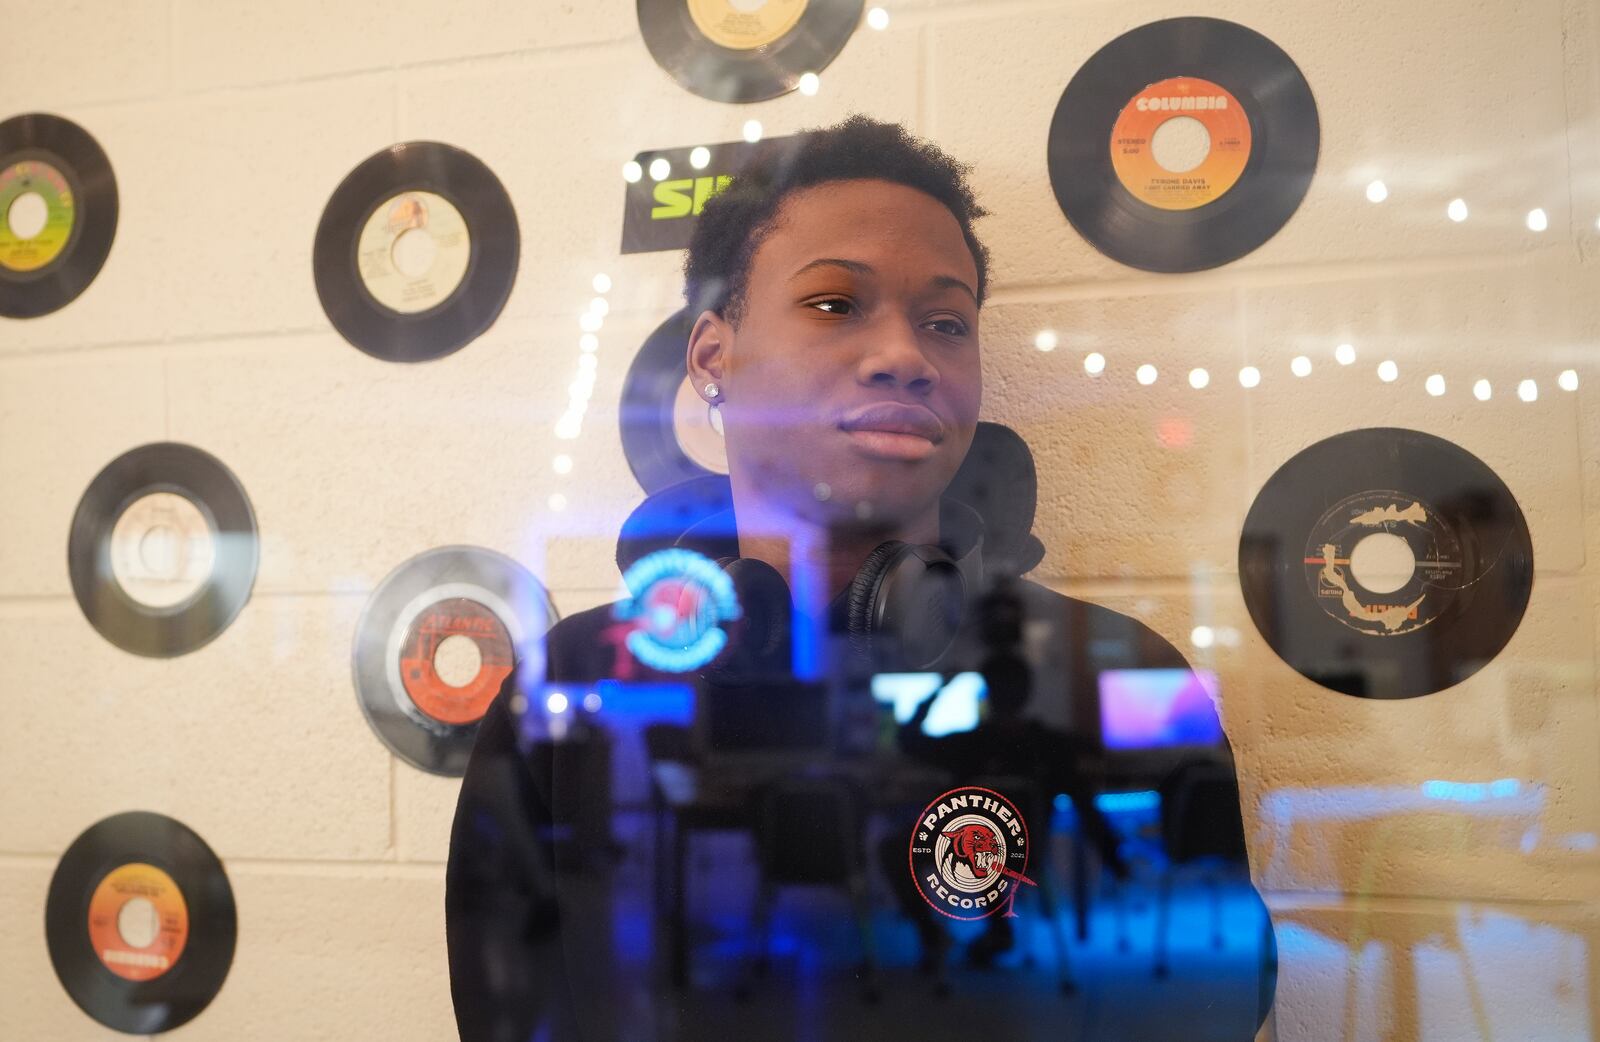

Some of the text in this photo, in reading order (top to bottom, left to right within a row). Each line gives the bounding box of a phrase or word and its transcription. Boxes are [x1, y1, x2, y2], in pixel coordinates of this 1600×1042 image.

[1135, 95, 1228, 112] COLUMBIA
[923, 795, 1021, 837] PANTHER
[926, 873, 1008, 909] RECORDS
